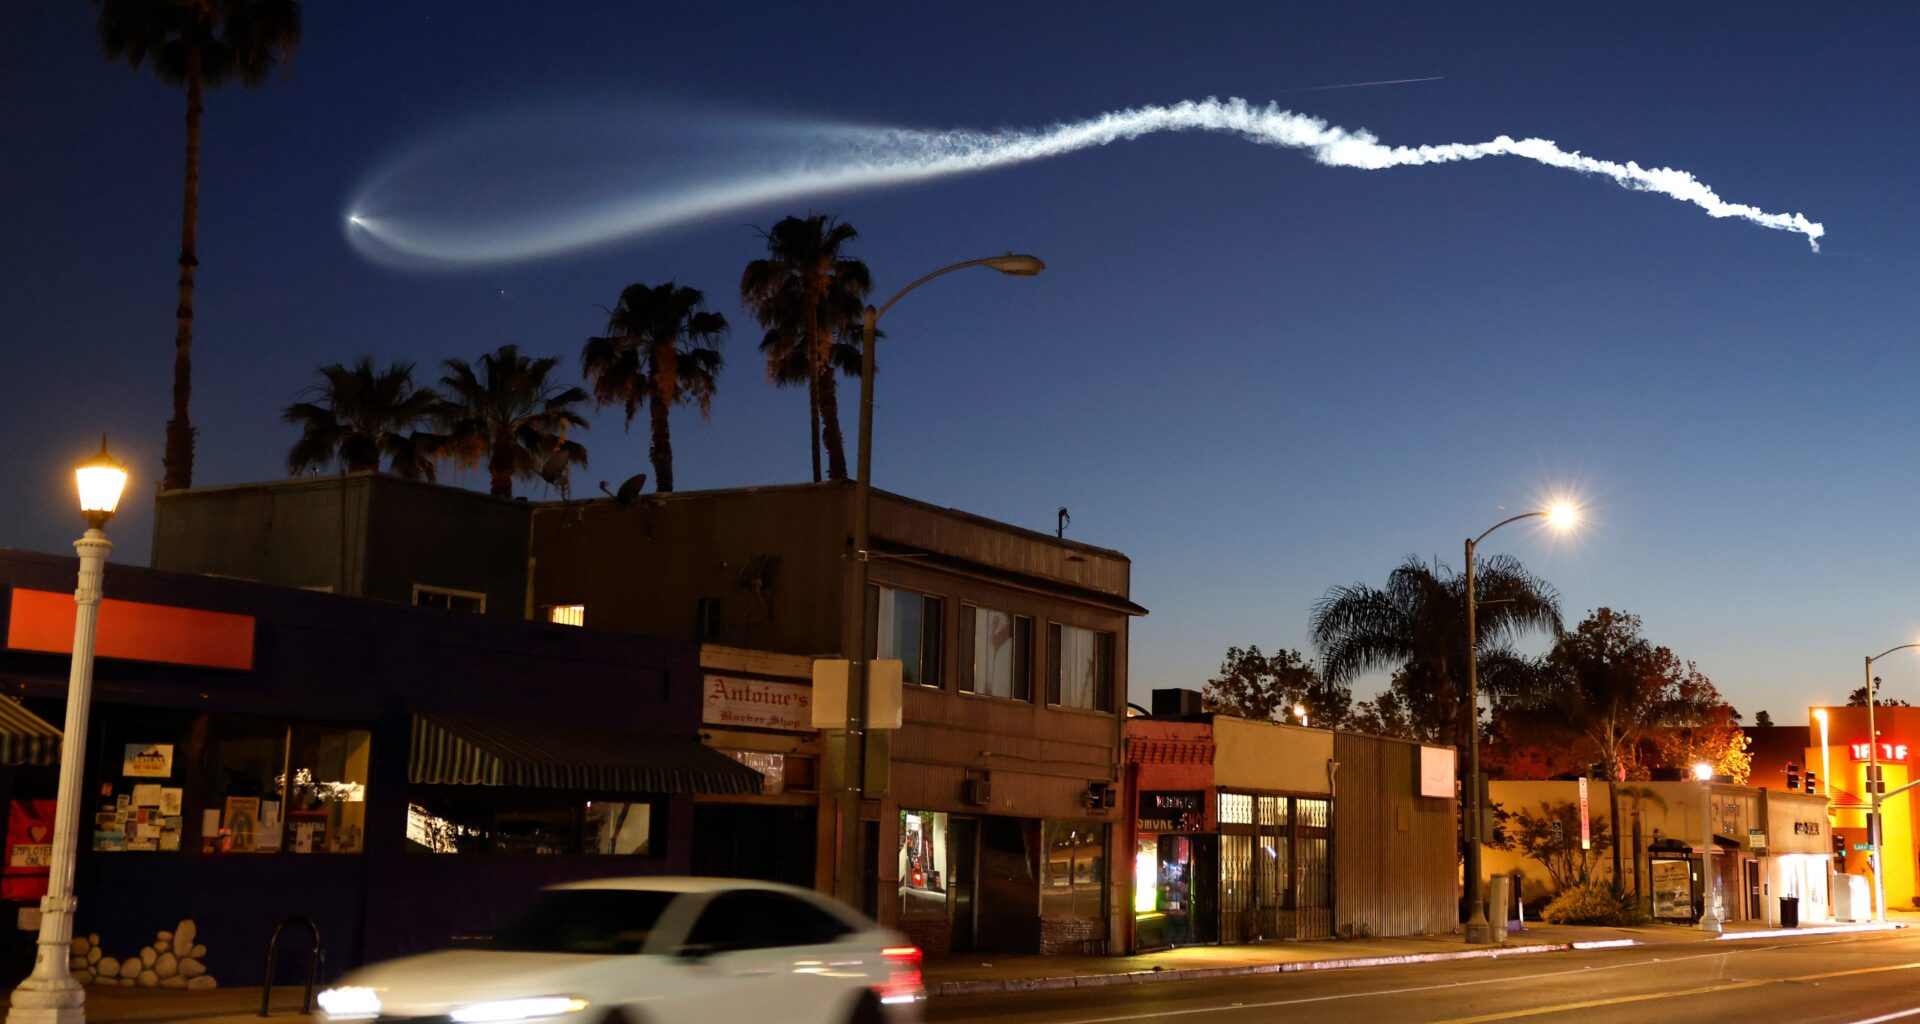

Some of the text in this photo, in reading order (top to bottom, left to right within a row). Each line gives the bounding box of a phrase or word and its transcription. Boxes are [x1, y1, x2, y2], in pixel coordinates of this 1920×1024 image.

[707, 678, 808, 708] Antoine's
[720, 710, 801, 728] Barber Shop
[1179, 812, 1207, 831] SHO
[25, 856, 47, 866] ONLY
